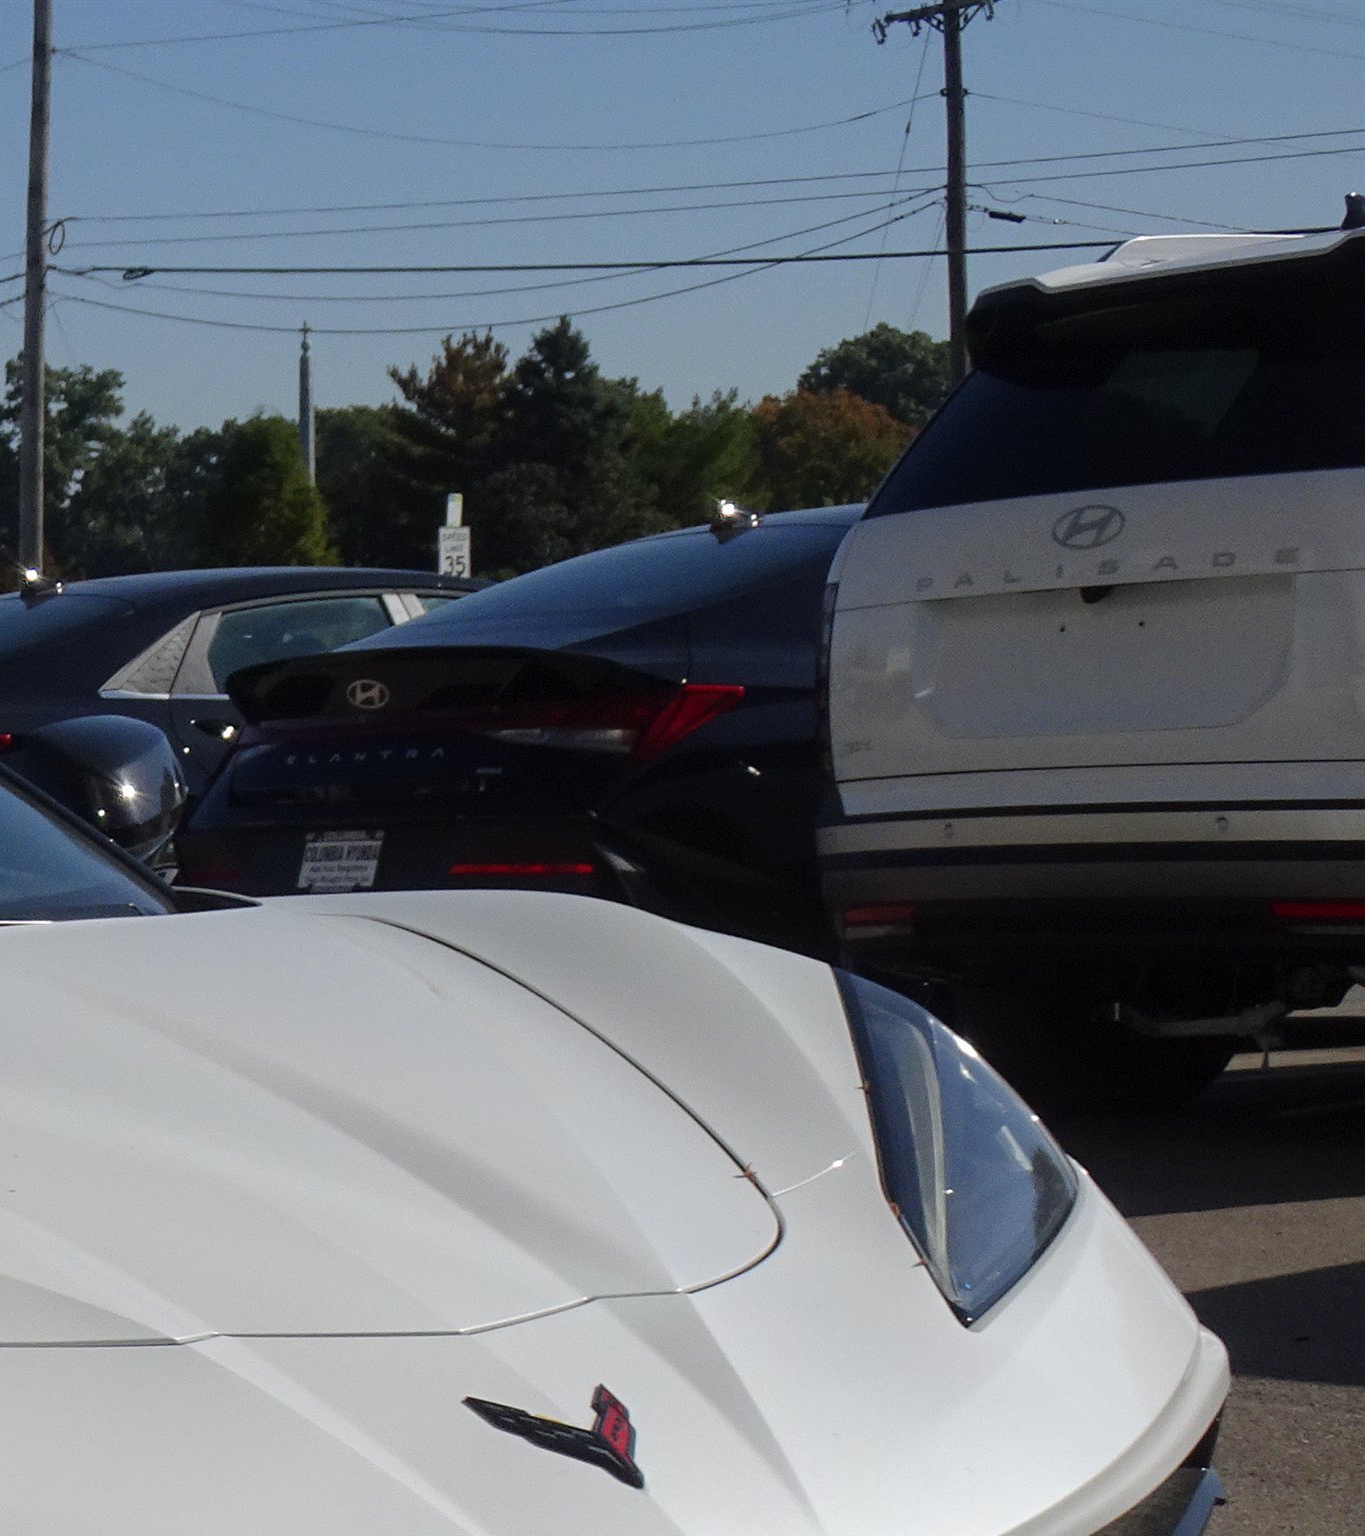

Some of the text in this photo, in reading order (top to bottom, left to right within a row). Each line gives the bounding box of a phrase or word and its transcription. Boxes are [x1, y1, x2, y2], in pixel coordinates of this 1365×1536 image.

[444, 555, 466, 577] 35
[914, 547, 1300, 594] PALISADE
[286, 748, 446, 765] ELANTRA
